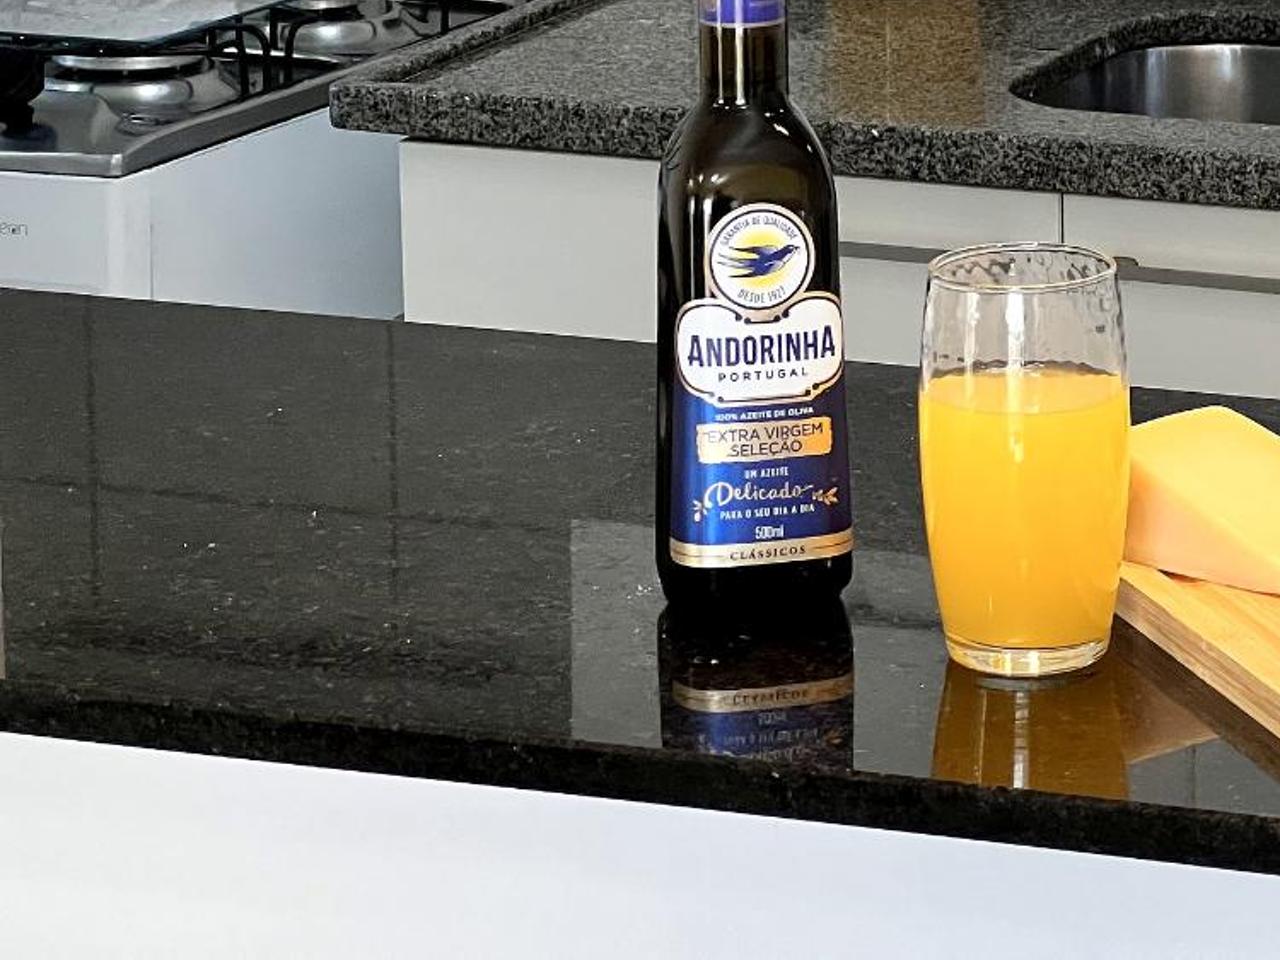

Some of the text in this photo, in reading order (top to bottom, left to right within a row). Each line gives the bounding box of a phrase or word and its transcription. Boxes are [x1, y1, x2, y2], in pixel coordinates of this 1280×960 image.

[737, 288, 766, 303] DESDE
[687, 324, 836, 368] ANDORINHA
[718, 367, 809, 383] PORTUGAL
[715, 406, 814, 422] 100% AZEITE DE OLIVA
[708, 422, 824, 444] EXTRA VIRGEM
[730, 438, 803, 457] SELEÇÃO
[744, 466, 789, 479] UM AZEITE
[703, 481, 814, 509] Delicado
[720, 509, 743, 520] PARA
[745, 508, 752, 519] O
[754, 506, 770, 518] SEU
[773, 505, 788, 516] DIA
[800, 503, 815, 514] DIA
[755, 523, 785, 540] 500ml
[730, 545, 807, 561] CLÁSSICOS
